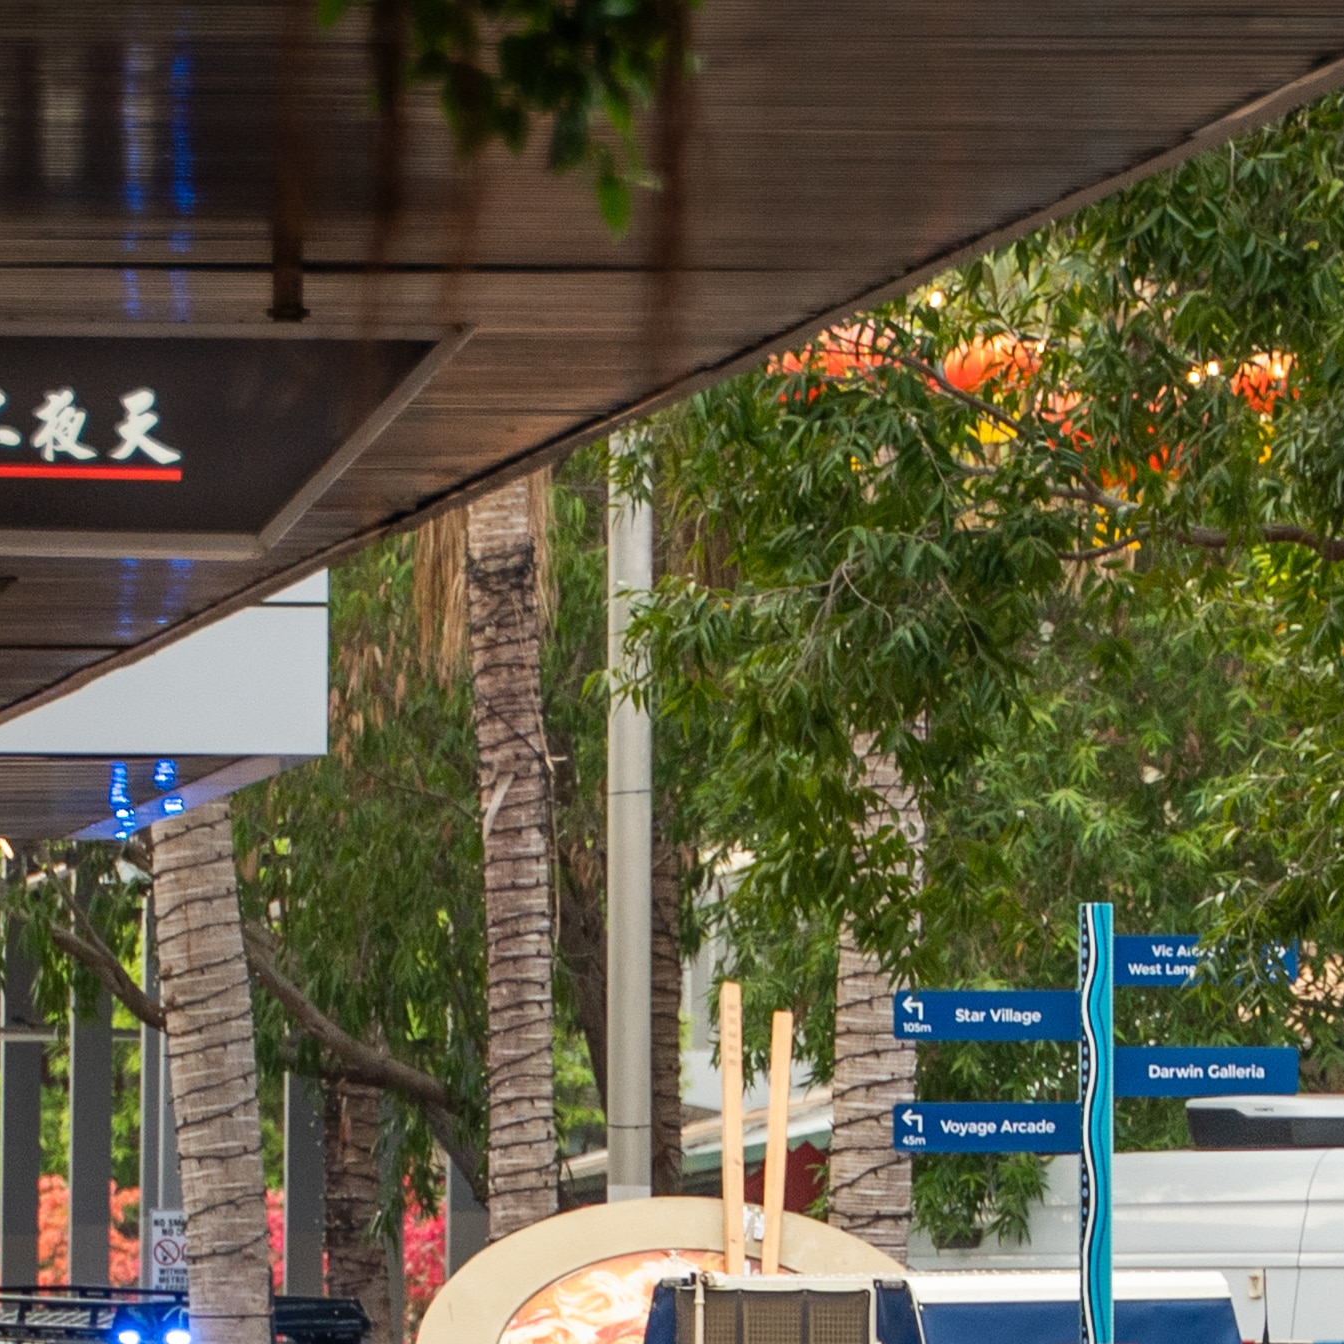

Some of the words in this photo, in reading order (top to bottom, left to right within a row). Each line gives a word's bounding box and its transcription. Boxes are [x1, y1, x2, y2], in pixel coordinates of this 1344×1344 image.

[1151, 944, 1173, 957] Vic
[1128, 963, 1162, 975] West
[955, 1008, 986, 1022] Star
[990, 1008, 1042, 1025] Village
[903, 1022, 932, 1033] 105m
[1148, 1064, 1204, 1079] Darwin
[1207, 1064, 1265, 1079] Galleria
[940, 1119, 997, 1136] Voyage
[1000, 1119, 1056, 1134] Arcade
[902, 1135, 926, 1146] 45m
